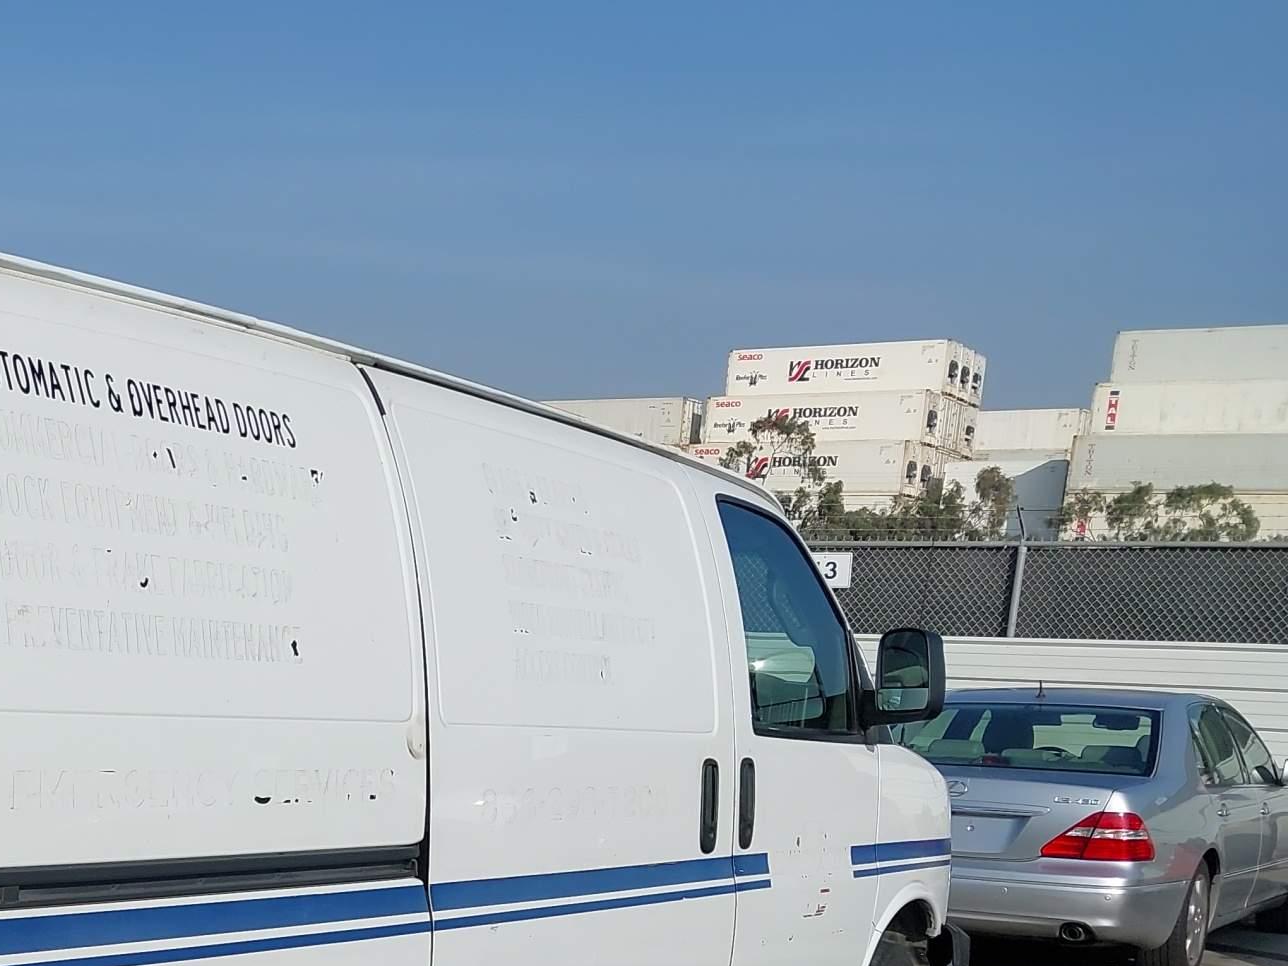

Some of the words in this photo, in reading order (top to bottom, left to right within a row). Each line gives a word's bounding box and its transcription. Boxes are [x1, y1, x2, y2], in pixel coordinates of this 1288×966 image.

[737, 353, 763, 361] seaco
[814, 357, 880, 370] HORIZON
[812, 369, 871, 378] LINES
[105, 373, 124, 414] &
[127, 377, 231, 435] OVERHEAD
[232, 402, 297, 449] DOORS
[792, 406, 859, 418] HORIZON
[695, 448, 720, 456] seaco
